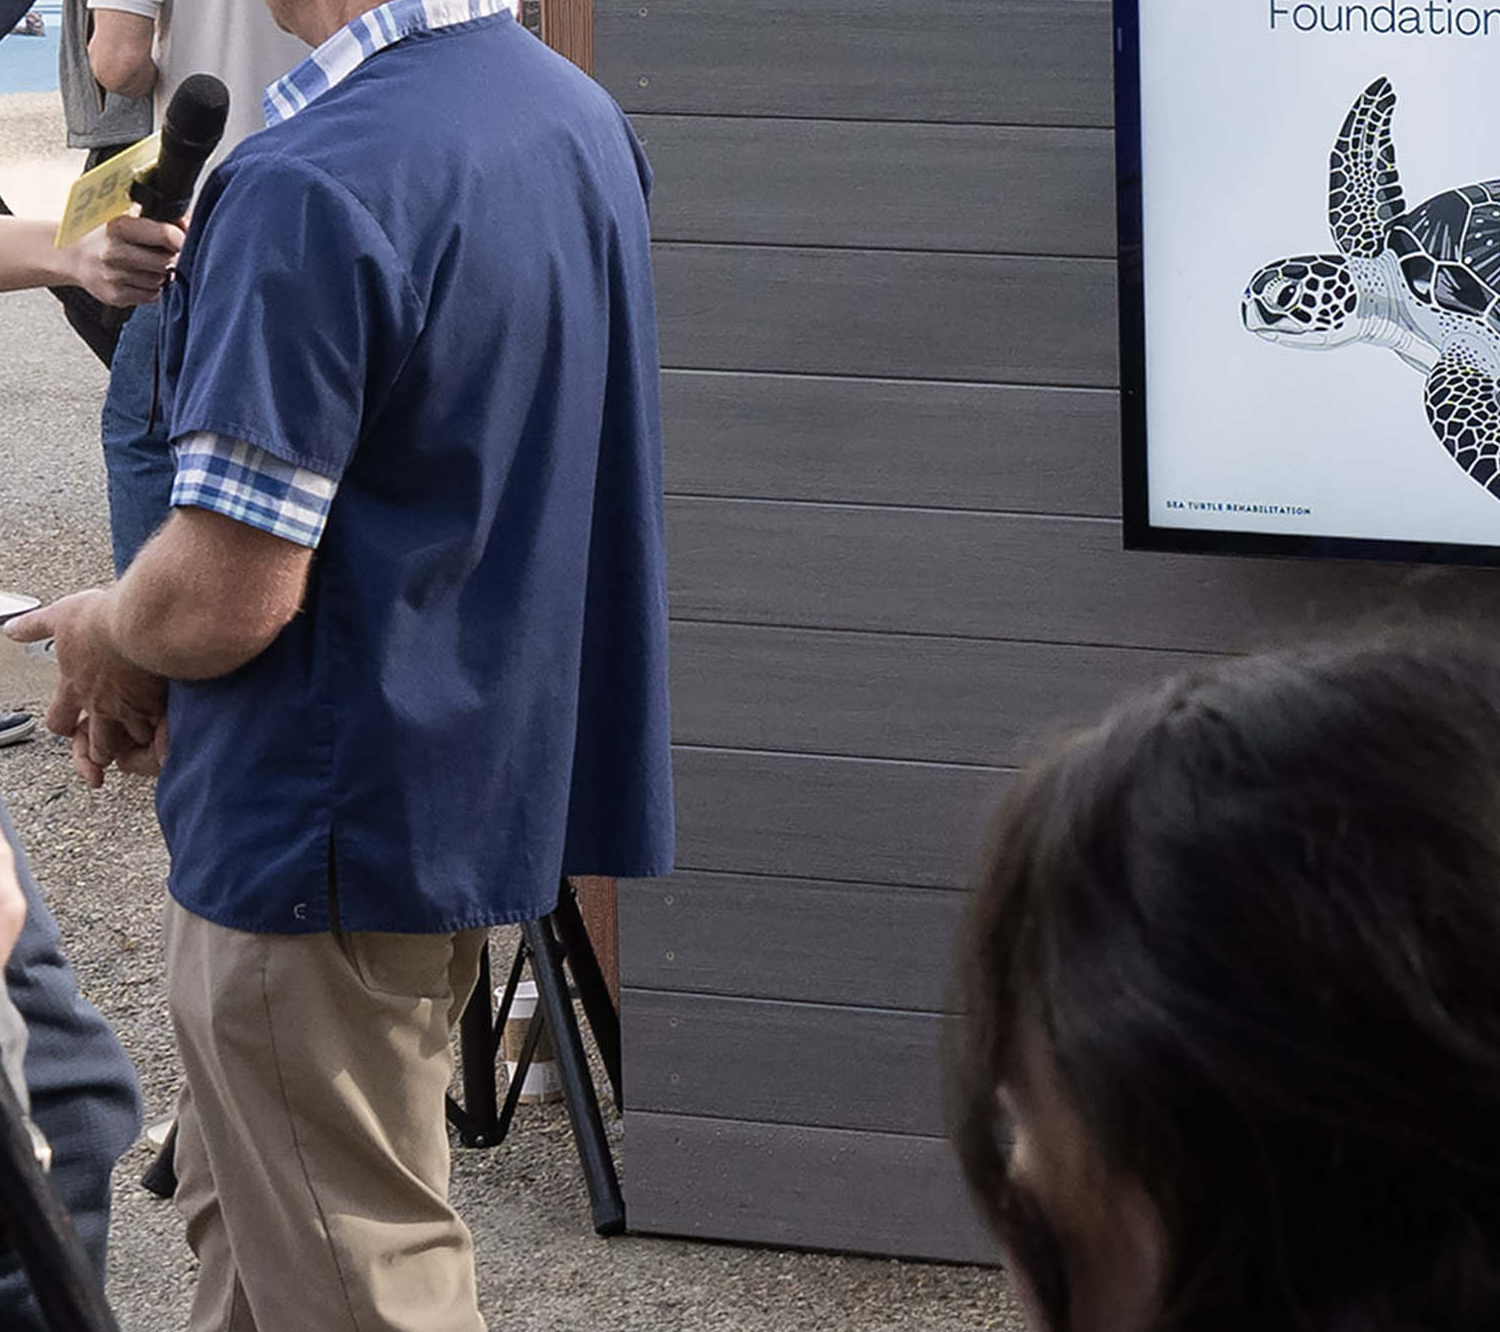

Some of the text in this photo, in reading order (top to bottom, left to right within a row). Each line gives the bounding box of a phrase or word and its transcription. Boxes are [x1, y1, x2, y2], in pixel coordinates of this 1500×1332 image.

[1166, 500, 1311, 516] SEA TURTLE REHABILITATION
